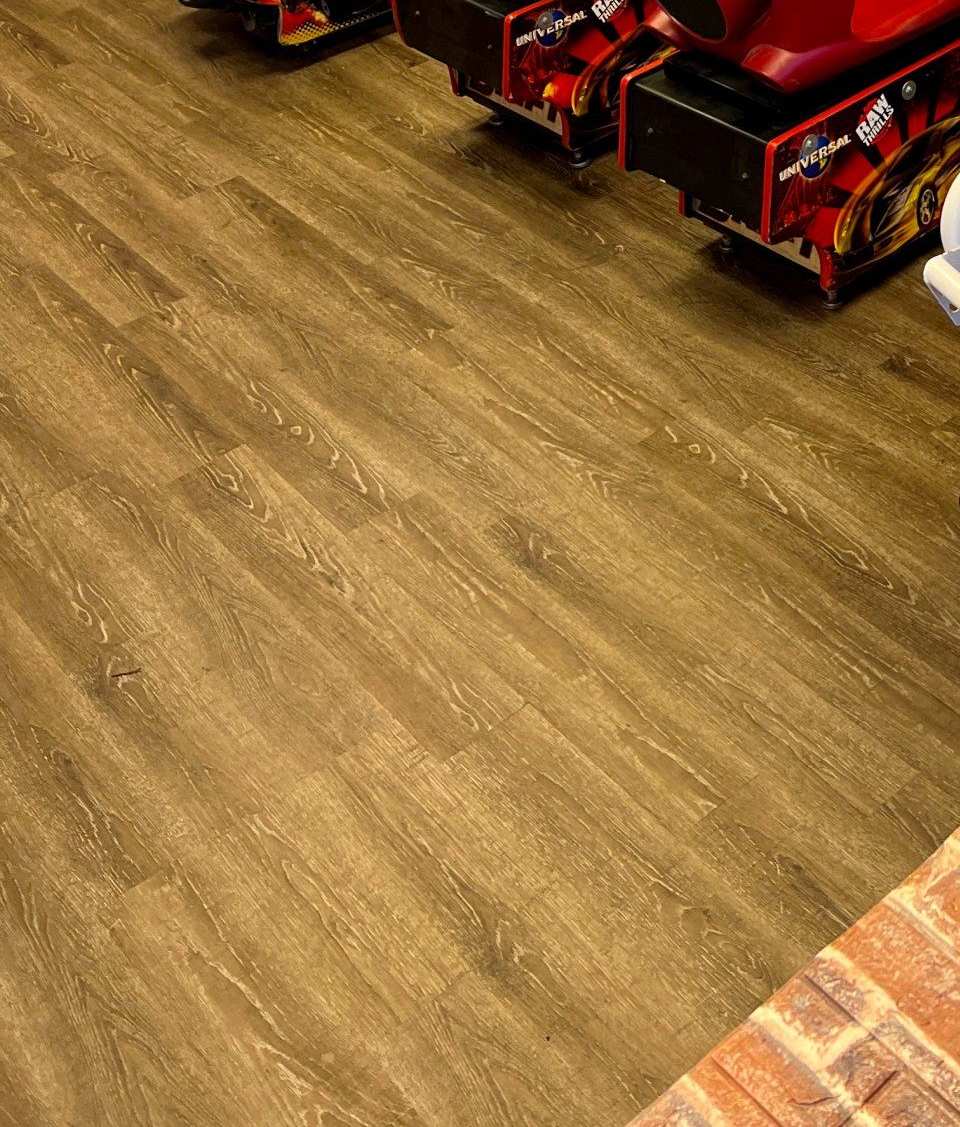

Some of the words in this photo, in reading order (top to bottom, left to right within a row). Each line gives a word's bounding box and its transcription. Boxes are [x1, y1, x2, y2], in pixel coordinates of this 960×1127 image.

[515, 10, 588, 47] UNIVERSAL
[855, 93, 890, 141] RAW
[862, 104, 895, 147] THRILLS
[778, 134, 852, 182] UNIVERSAL
